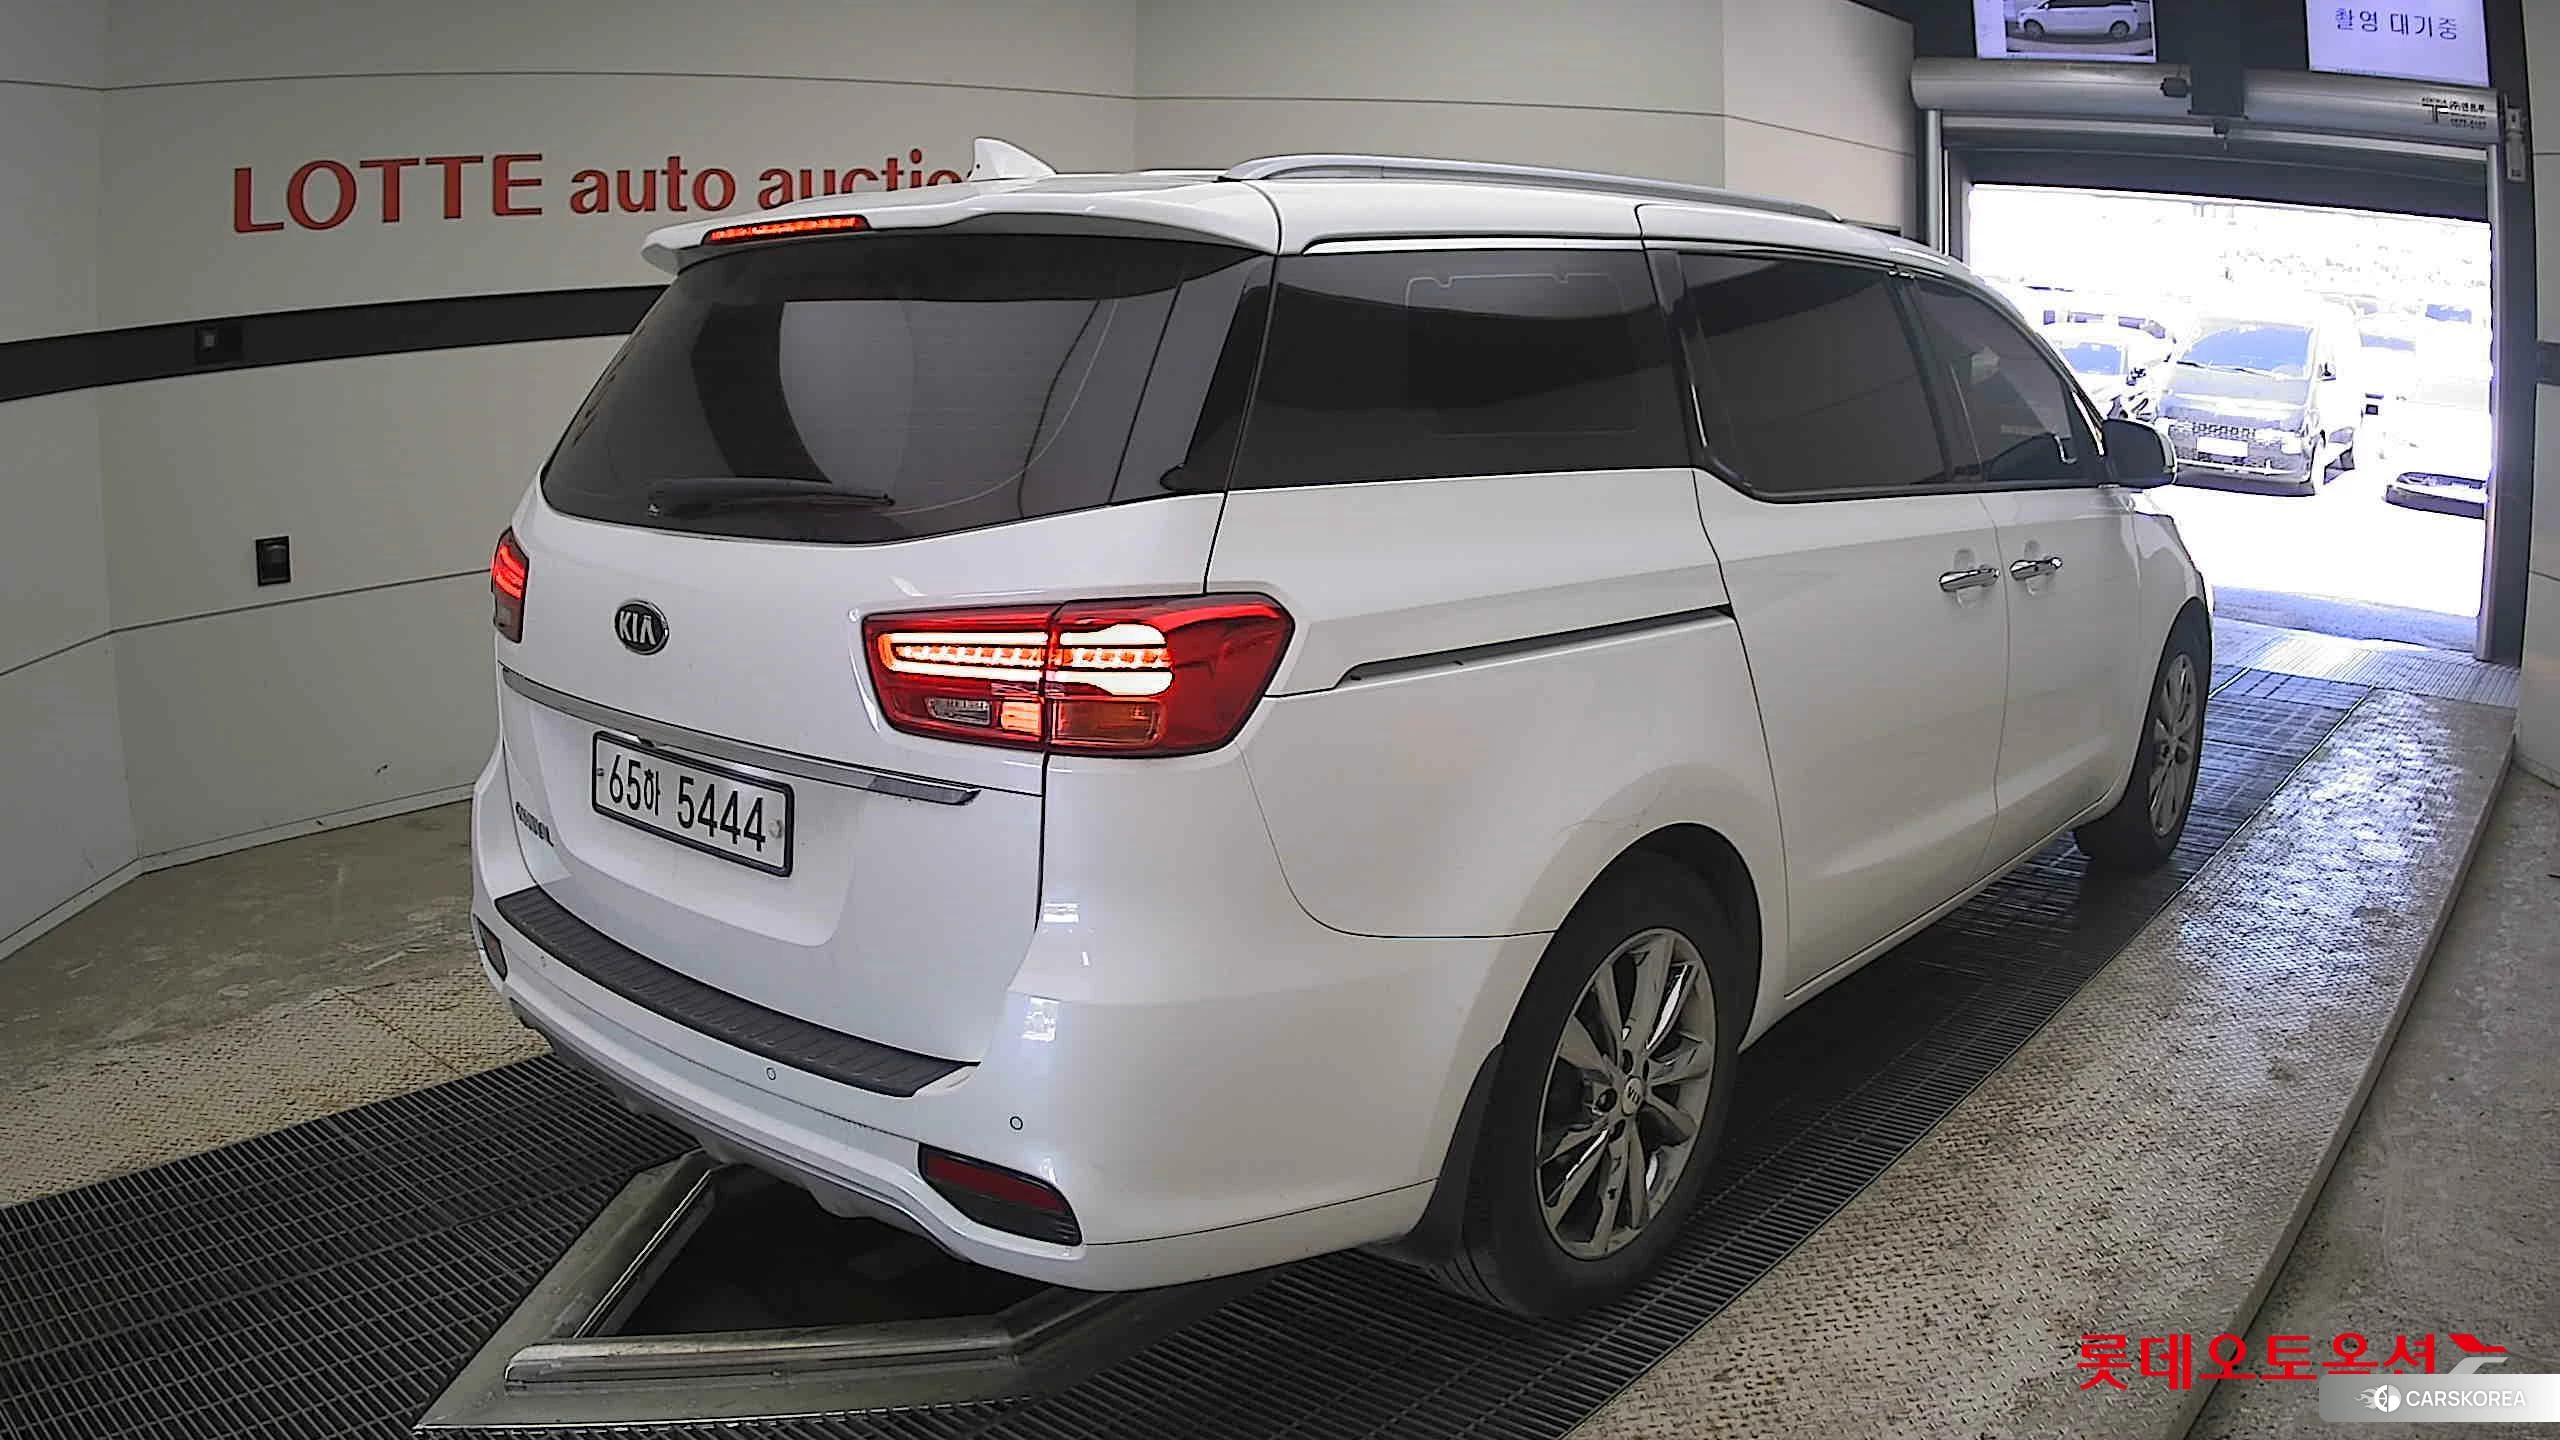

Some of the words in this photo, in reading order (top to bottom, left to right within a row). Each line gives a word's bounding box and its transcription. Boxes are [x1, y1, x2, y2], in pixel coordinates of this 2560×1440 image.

[2390, 12, 2457, 40] 대기중
[233, 153, 543, 234] LOTTE
[569, 155, 736, 214] auto
[619, 610, 656, 645] KIA
[609, 754, 660, 816] 65하
[677, 775, 766, 852] 5444
